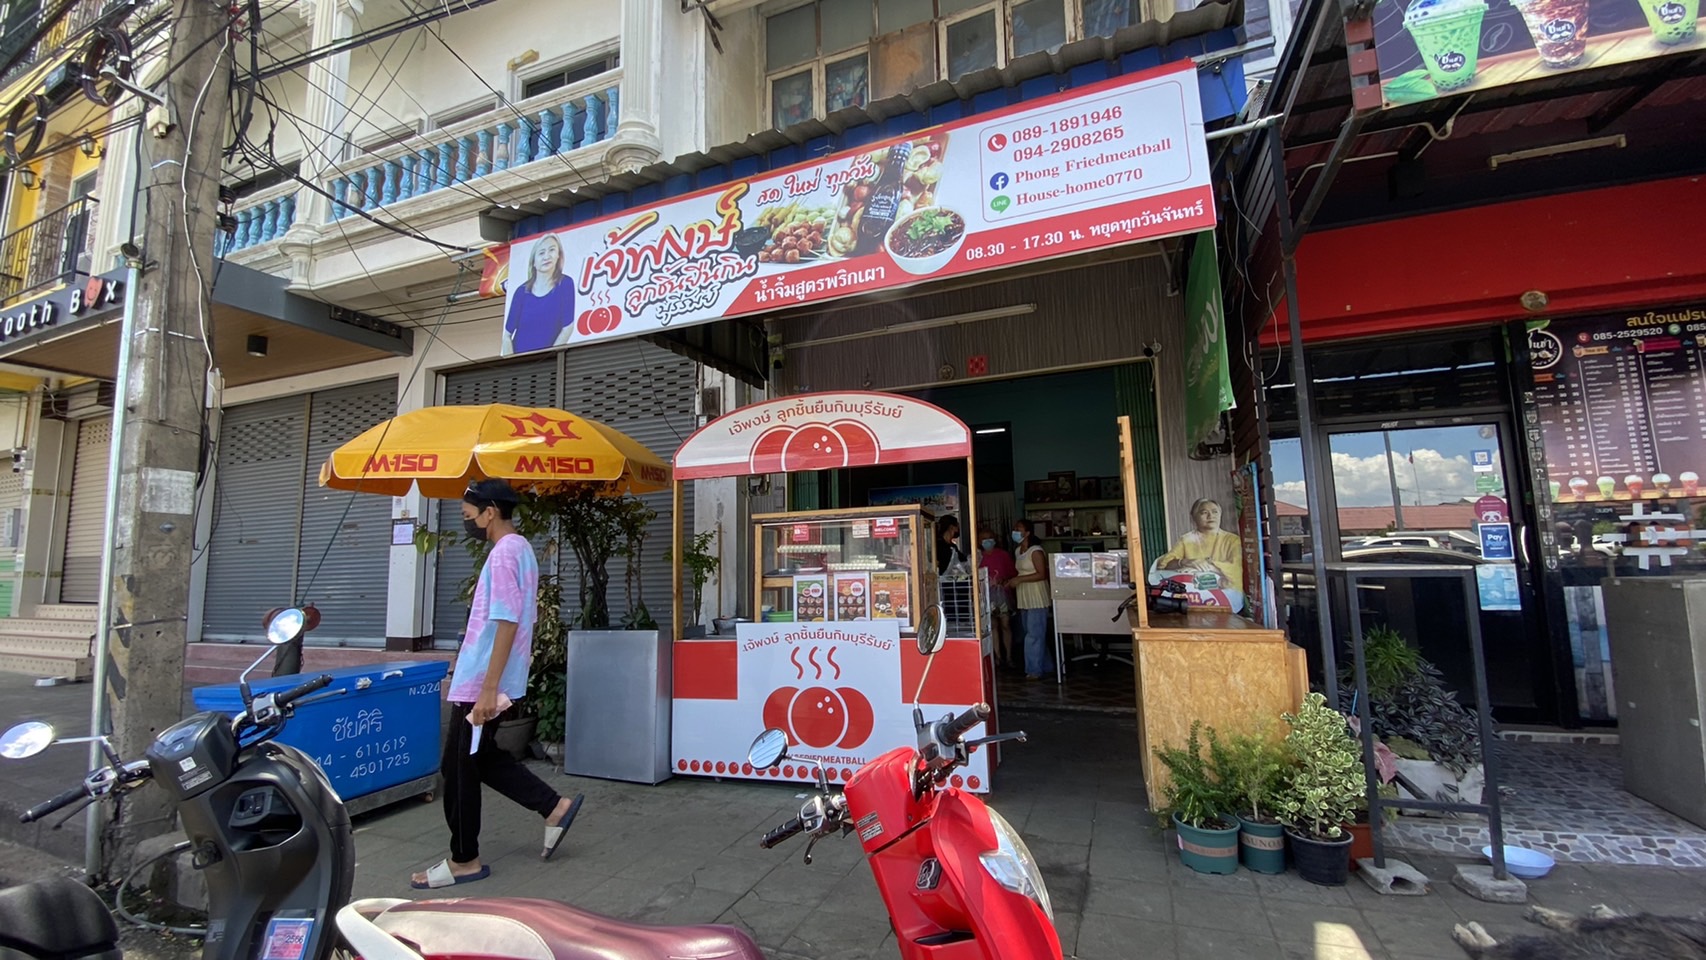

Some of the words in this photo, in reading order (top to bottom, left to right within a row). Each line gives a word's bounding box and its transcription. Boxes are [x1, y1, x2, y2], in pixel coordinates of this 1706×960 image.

[1012, 106, 1122, 143] 089-1891946
[1013, 125, 1124, 162] 094-2908265
[1015, 165, 1060, 184] Phong
[1065, 138, 1171, 173] Friedmeatball
[756, 187, 782, 205] สด
[784, 168, 822, 197] ใหม่
[826, 155, 876, 197] ทุกวัน
[1016, 168, 1143, 206] House-home0770
[966, 243, 1005, 261] 08.30
[1023, 231, 1063, 250] 17.30
[1069, 228, 1084, 241] น.
[1089, 199, 1204, 239] หยุดทุกวันจันทร์
[626, 253, 757, 313] ลูกชิ้นยืนกิน
[755, 265, 885, 302] น้ำจิ้มสูตรพริกเผา
[0, 301, 52, 335] ooth
[656, 286, 719, 325] บุรีรัมย์
[1593, 327, 1663, 341] 085-2529520
[729, 409, 771, 436] เจ้พงษ์
[777, 399, 904, 423] ลูกชิ้นยืนกินบุรีรัมย์
[362, 454, 438, 472] M-150
[514, 455, 594, 474] M-150
[744, 632, 779, 652] เจ้พงษ์
[785, 625, 892, 651] ลูกชิ้นยืนกินบุรีรัมย์
[332, 708, 383, 742] ชัยศิริ
[350, 752, 410, 779] 4501725
